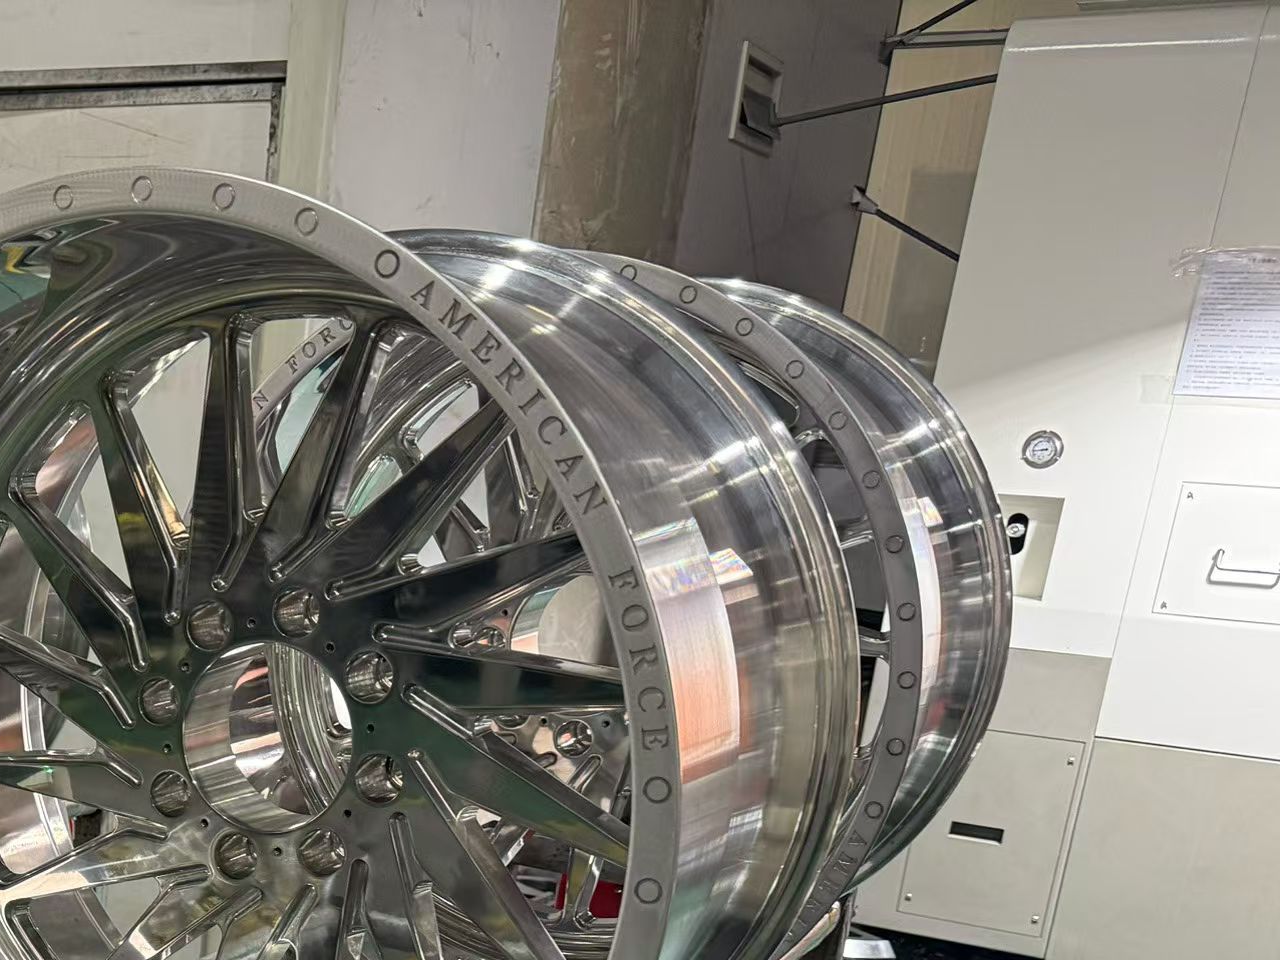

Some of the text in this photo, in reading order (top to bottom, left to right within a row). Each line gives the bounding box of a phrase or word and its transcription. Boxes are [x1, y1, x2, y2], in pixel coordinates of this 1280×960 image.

[284, 318, 353, 375] FORC
[410, 280, 670, 751] AMERICAN FORCE
